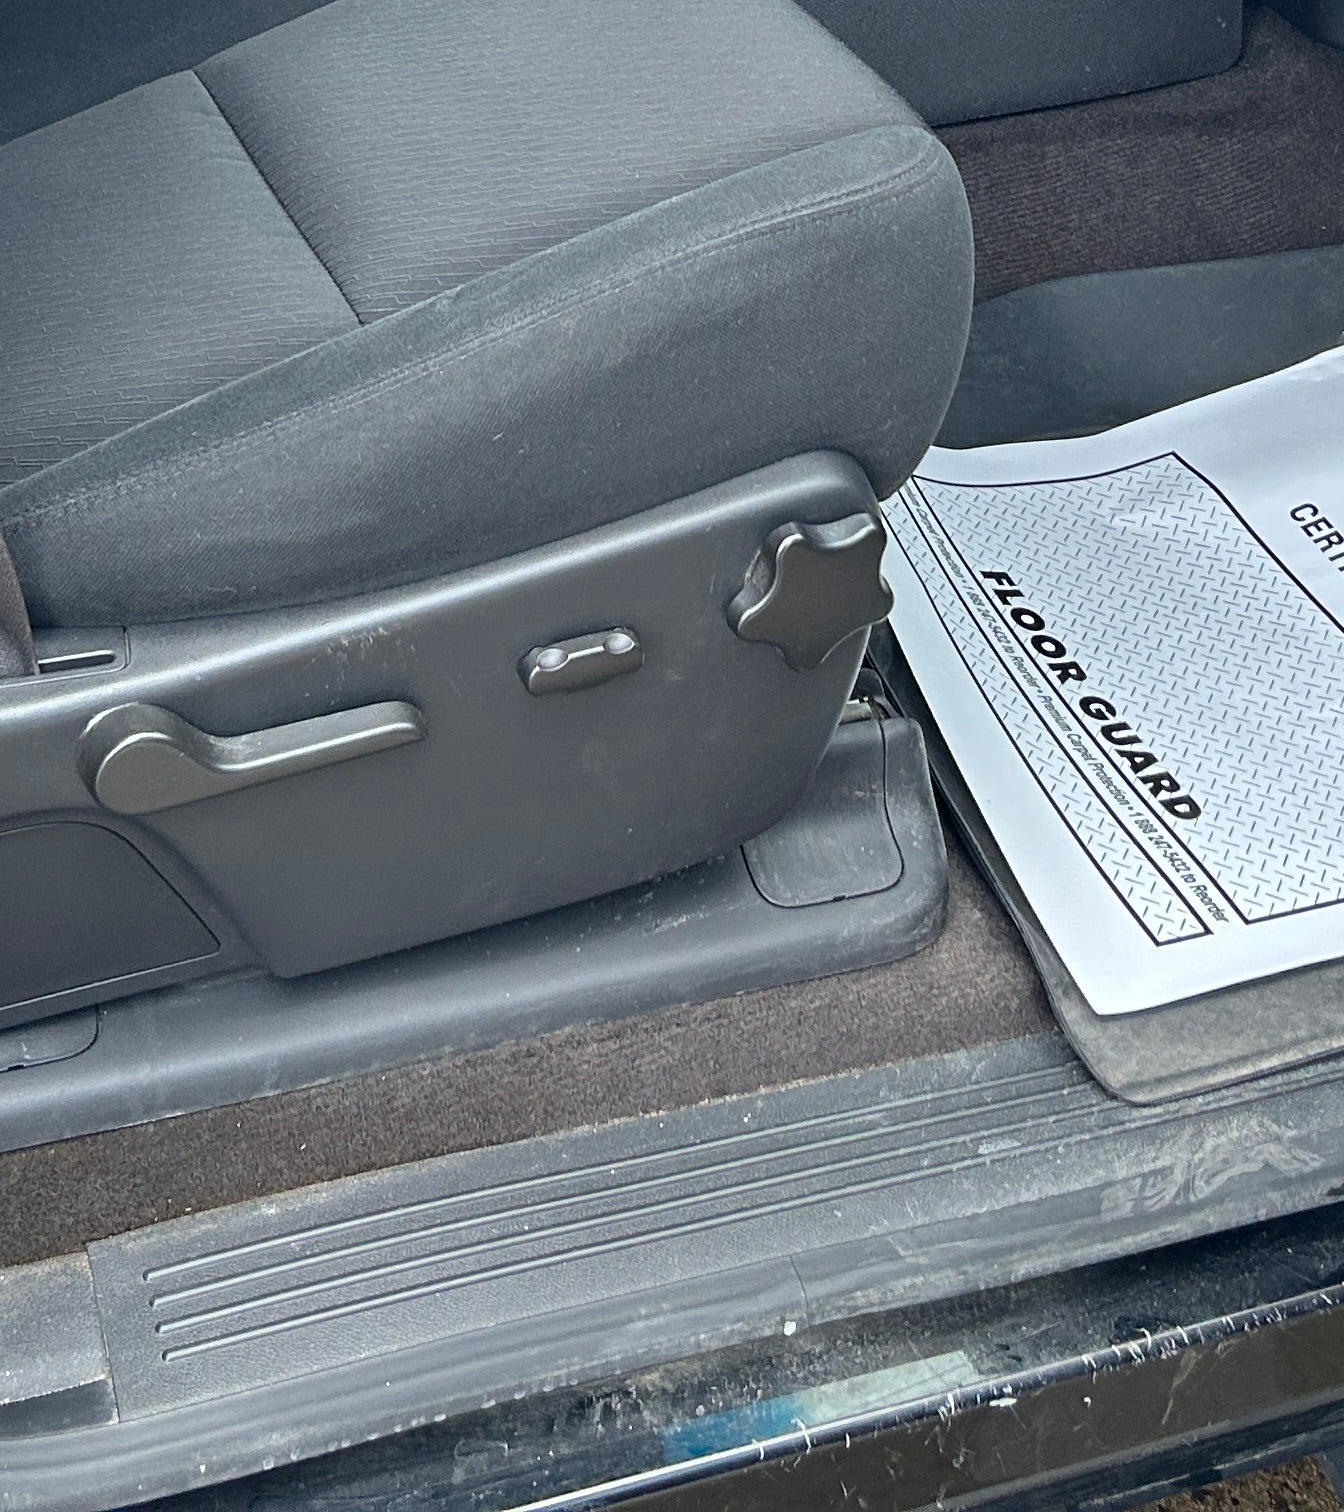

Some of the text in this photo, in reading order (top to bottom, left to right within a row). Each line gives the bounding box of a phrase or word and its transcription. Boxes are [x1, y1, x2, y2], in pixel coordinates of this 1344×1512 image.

[979, 570, 1202, 820] FLOOR GUARD
[1002, 645, 1016, 654] to
[1009, 655, 1041, 689] Reorder
[1036, 694, 1073, 732] Premium
[1066, 733, 1098, 762] Carpet
[1087, 762, 1131, 806] Protection
[1180, 873, 1197, 884] to
[1189, 884, 1230, 923] Reorder
